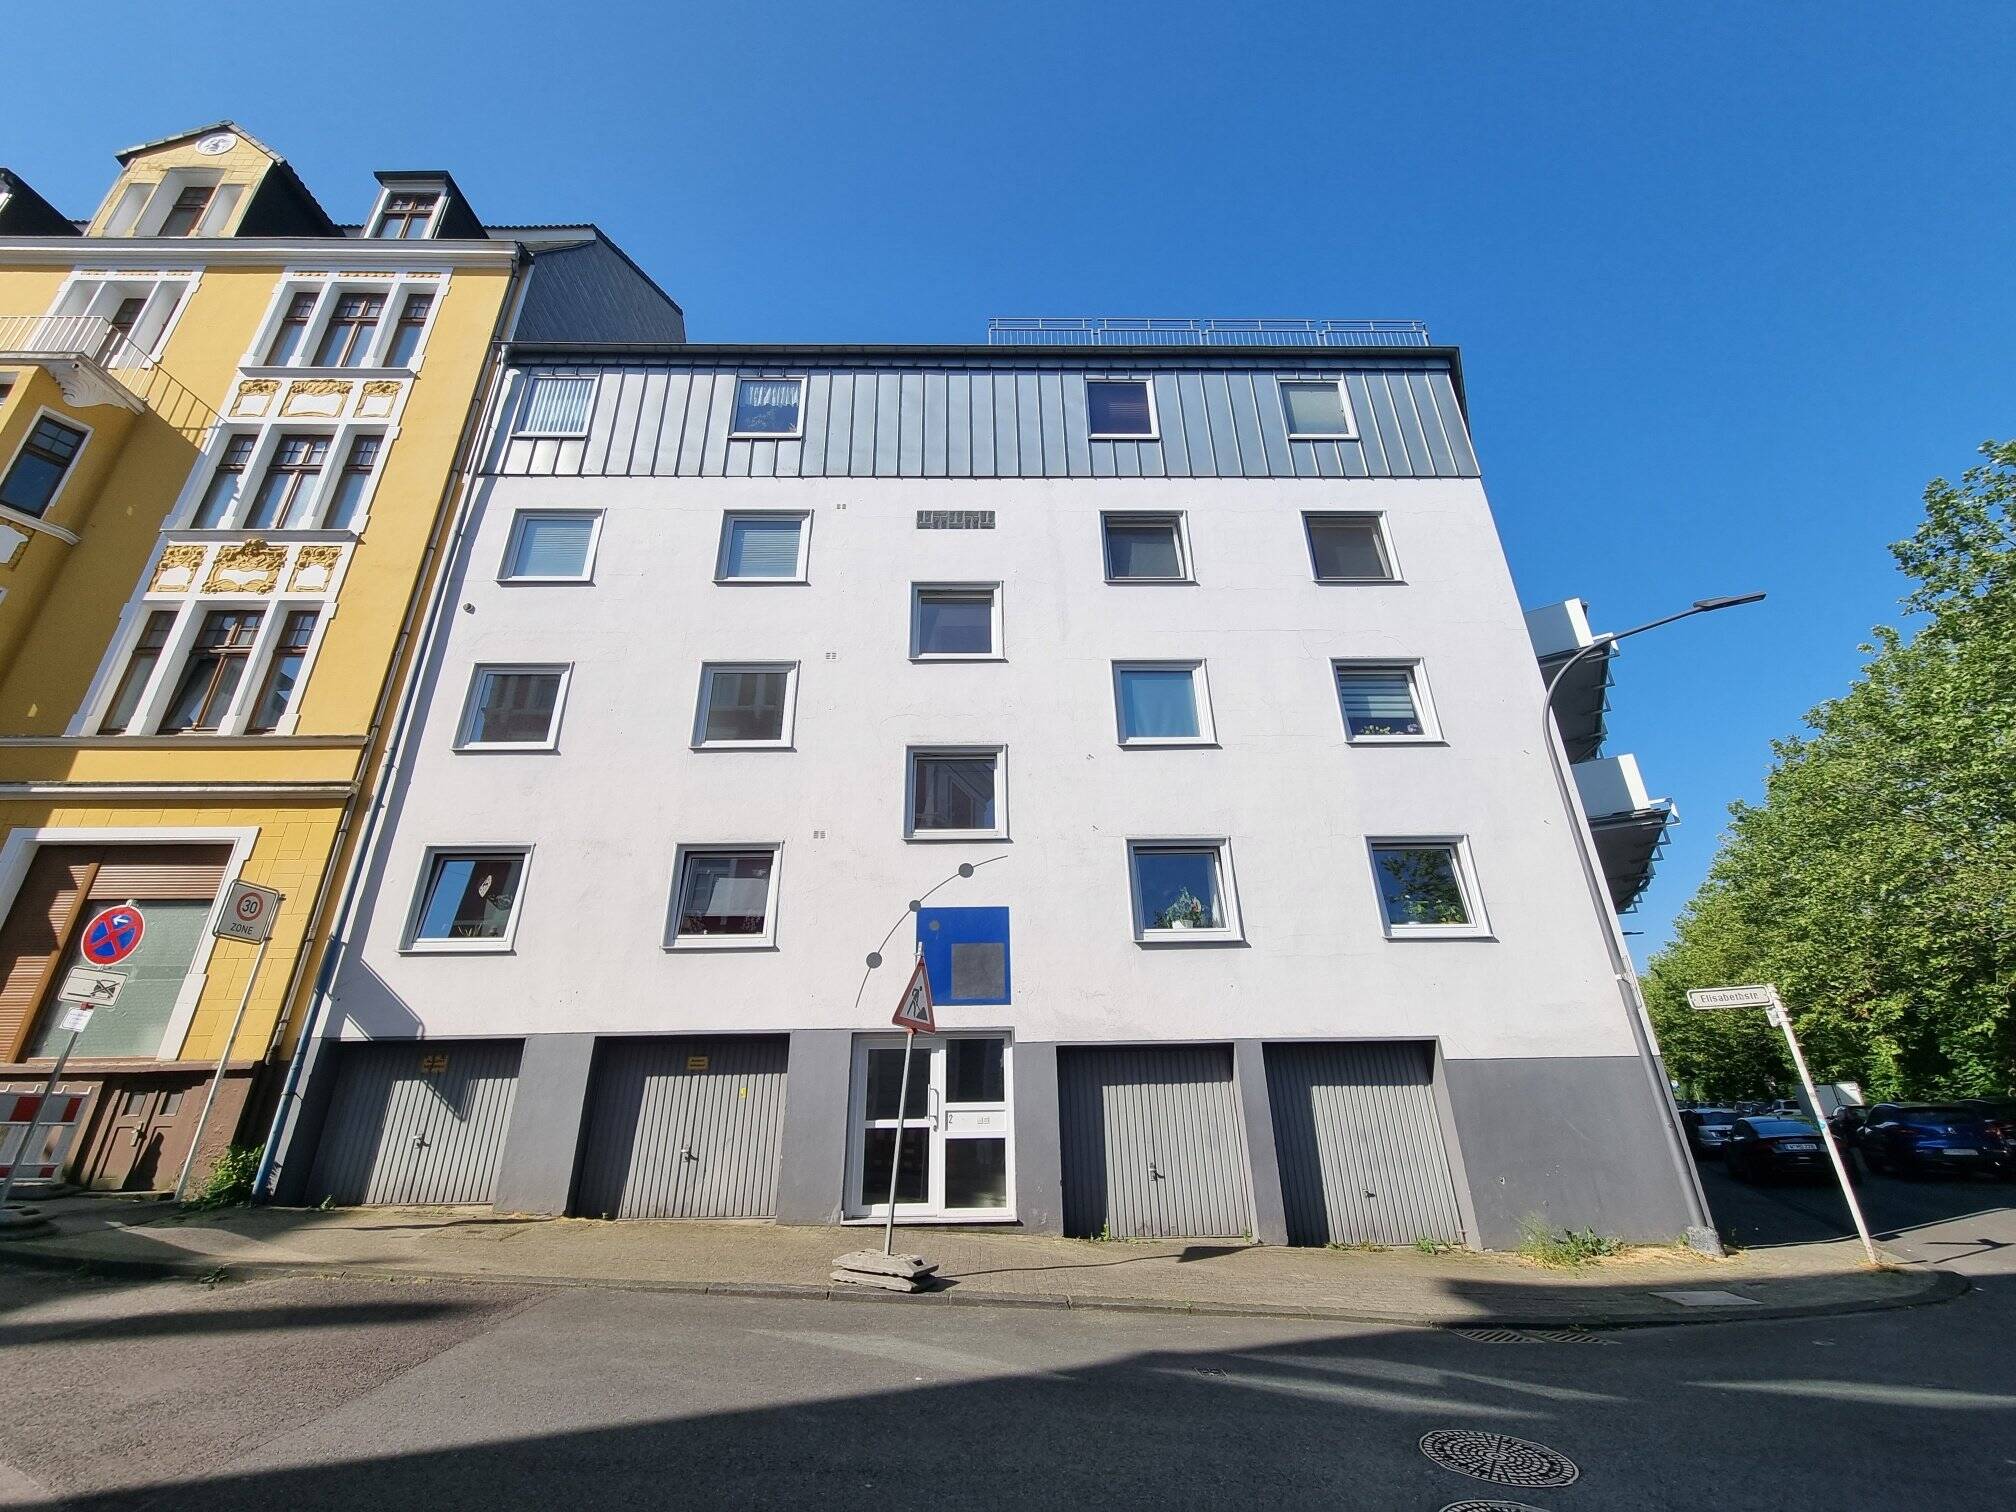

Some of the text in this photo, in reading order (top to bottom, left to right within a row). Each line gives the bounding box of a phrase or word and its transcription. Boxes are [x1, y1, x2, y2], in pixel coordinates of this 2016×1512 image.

[242, 899, 258, 914] 30
[230, 922, 254, 935] ZONE
[1700, 992, 1759, 1004] Elisabethstr.
